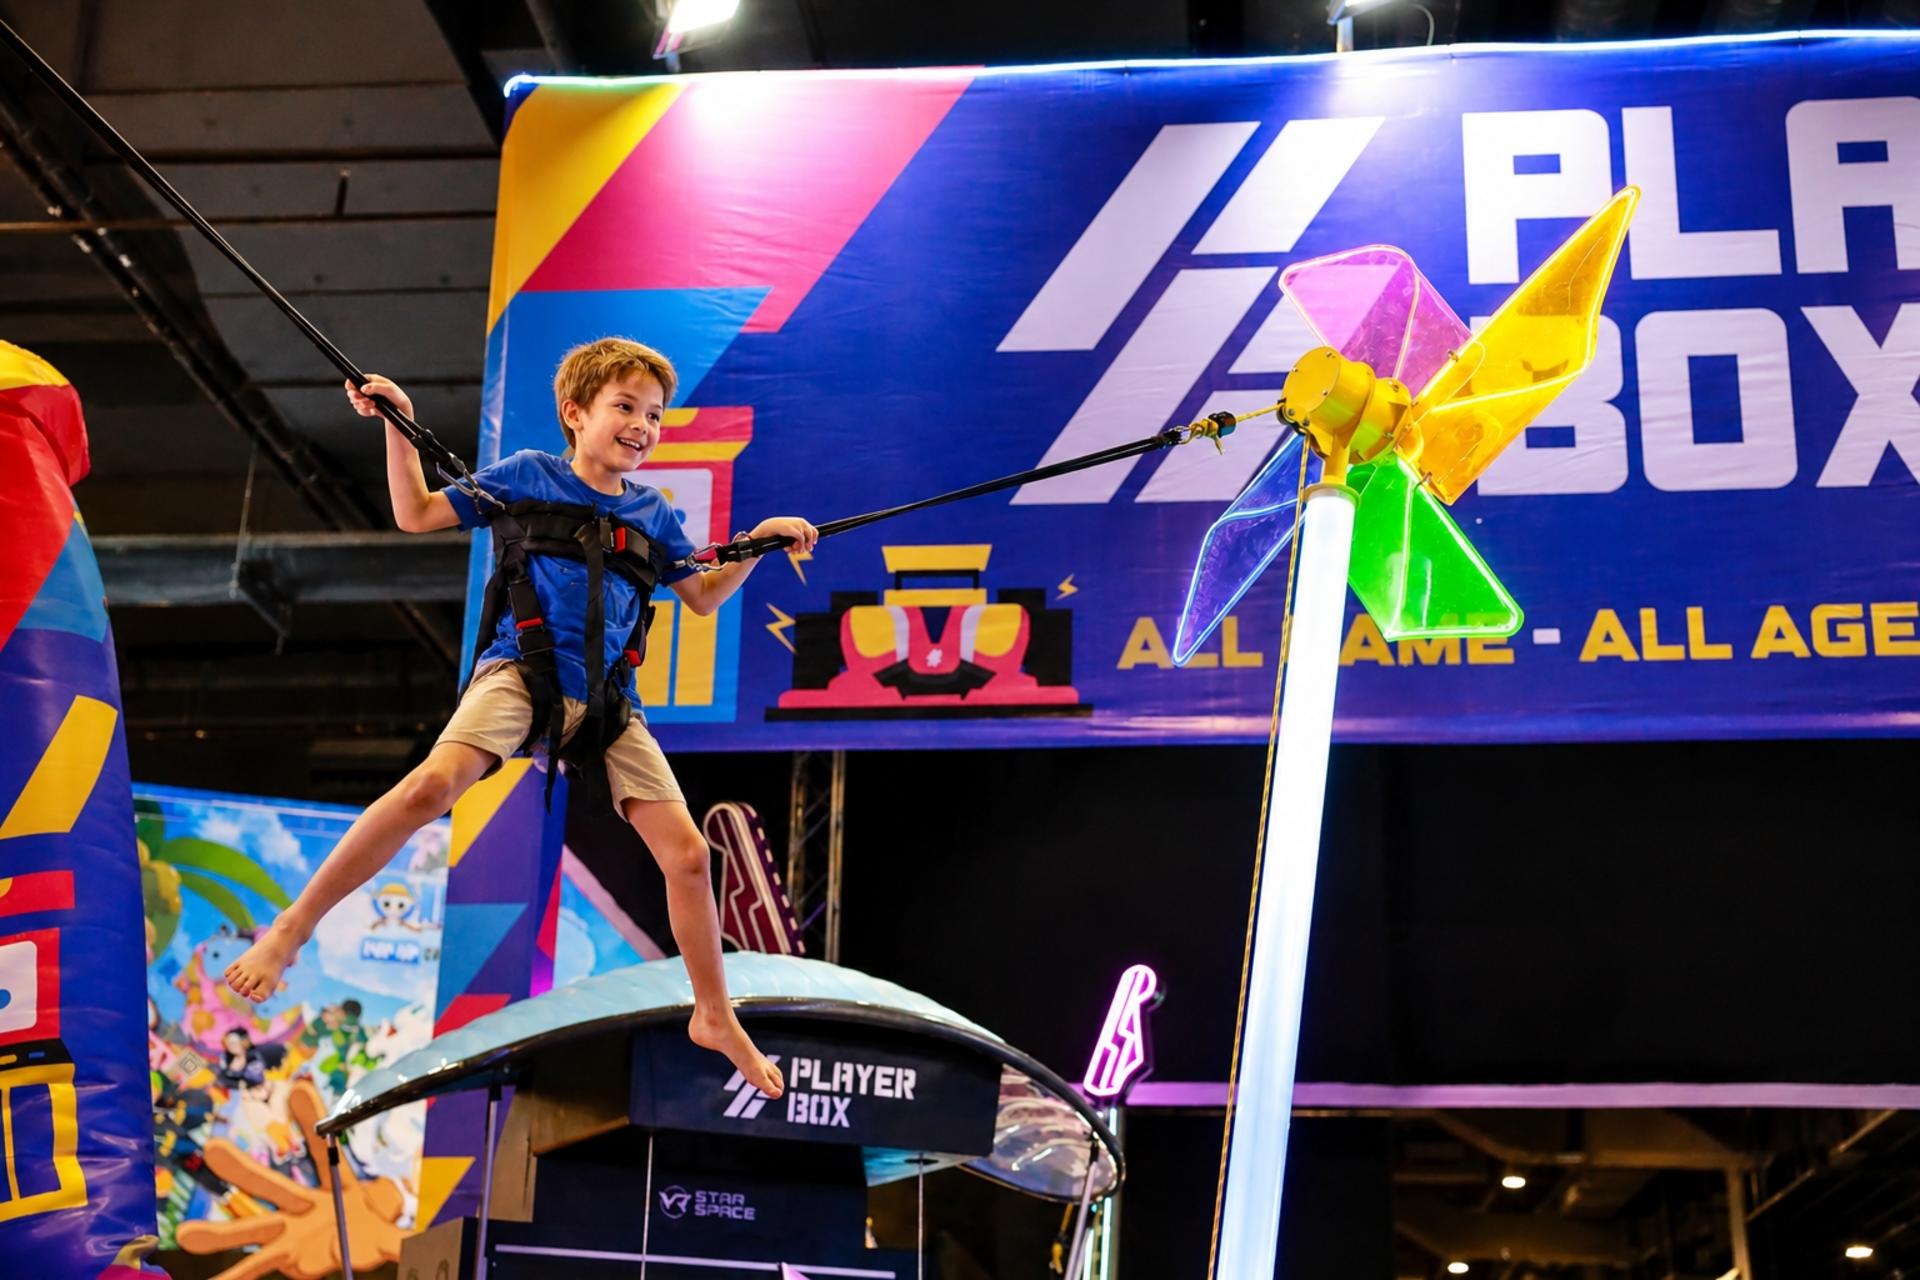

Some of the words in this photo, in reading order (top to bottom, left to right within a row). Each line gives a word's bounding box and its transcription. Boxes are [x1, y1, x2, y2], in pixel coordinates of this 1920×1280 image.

[1461, 96, 1920, 285] PLA
[1469, 302, 1920, 496] BOX
[1282, 612, 1515, 667] AME
[1579, 606, 1733, 662] ALL
[1750, 601, 1920, 658] AGE
[789, 1056, 917, 1100] PLAYER
[786, 1091, 851, 1128] BOX
[694, 1203, 756, 1221] SPACE
[695, 1190, 745, 1206] STAR
